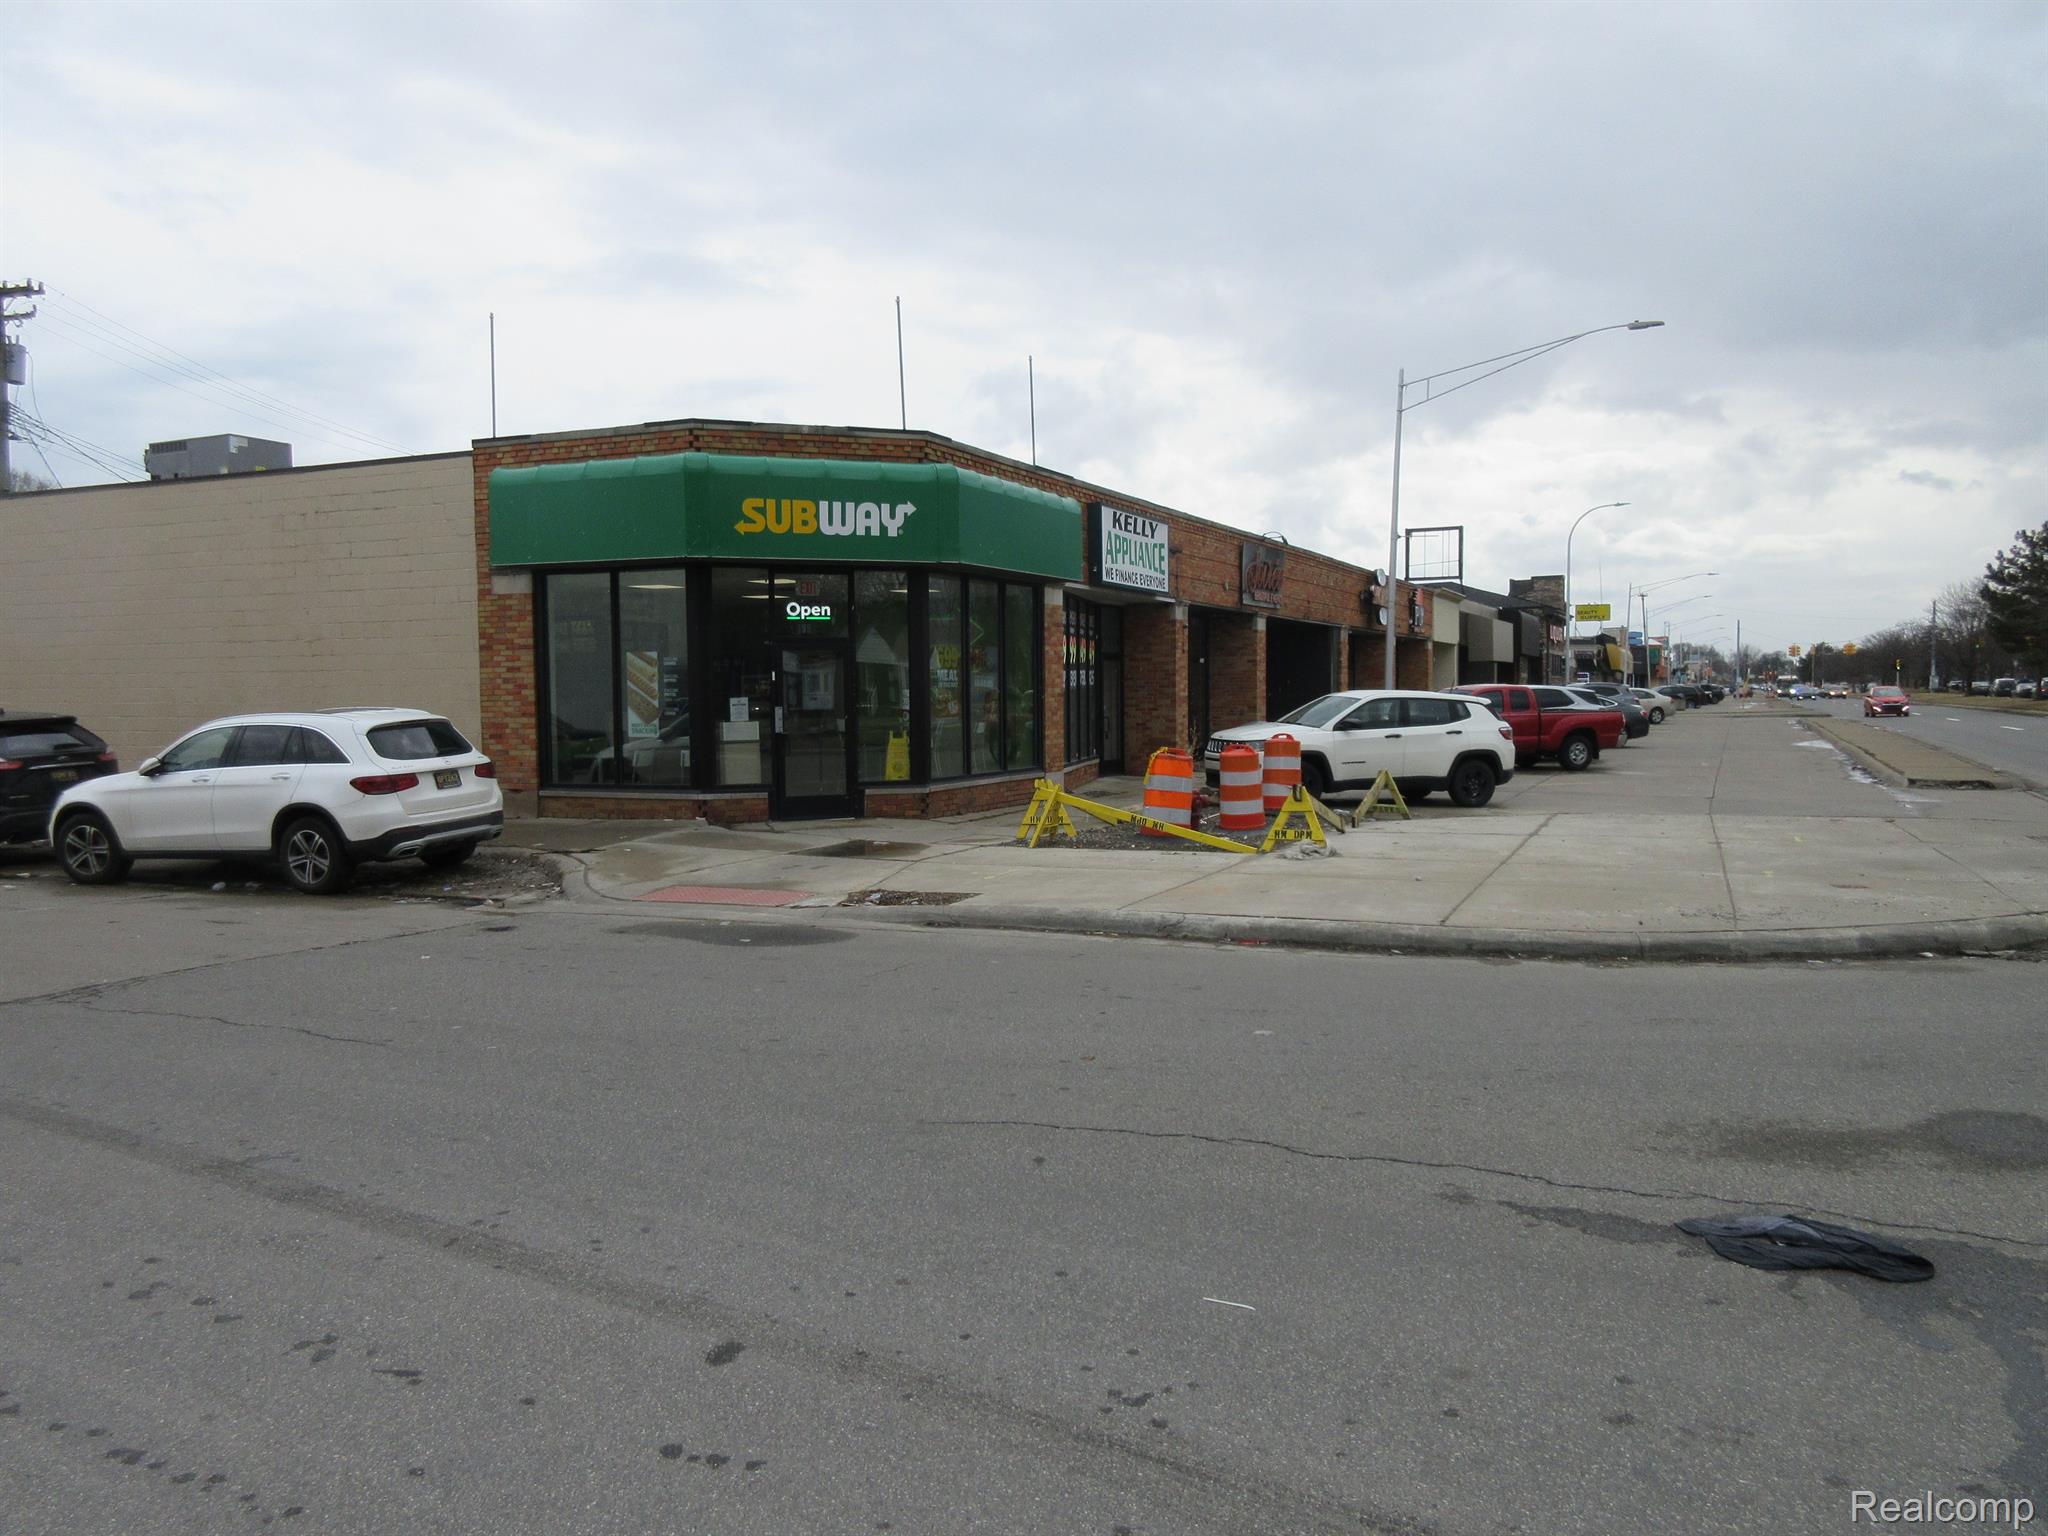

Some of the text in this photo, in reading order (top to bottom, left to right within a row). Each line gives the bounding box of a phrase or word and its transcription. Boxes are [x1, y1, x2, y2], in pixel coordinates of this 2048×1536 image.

[734, 498, 917, 537] SUBWAY
[1112, 511, 1158, 539] KELLY
[1105, 530, 1166, 577] APPLIANCE
[1105, 567, 1166, 590] WE FINANCE EVERYONE
[786, 602, 831, 620] Open
